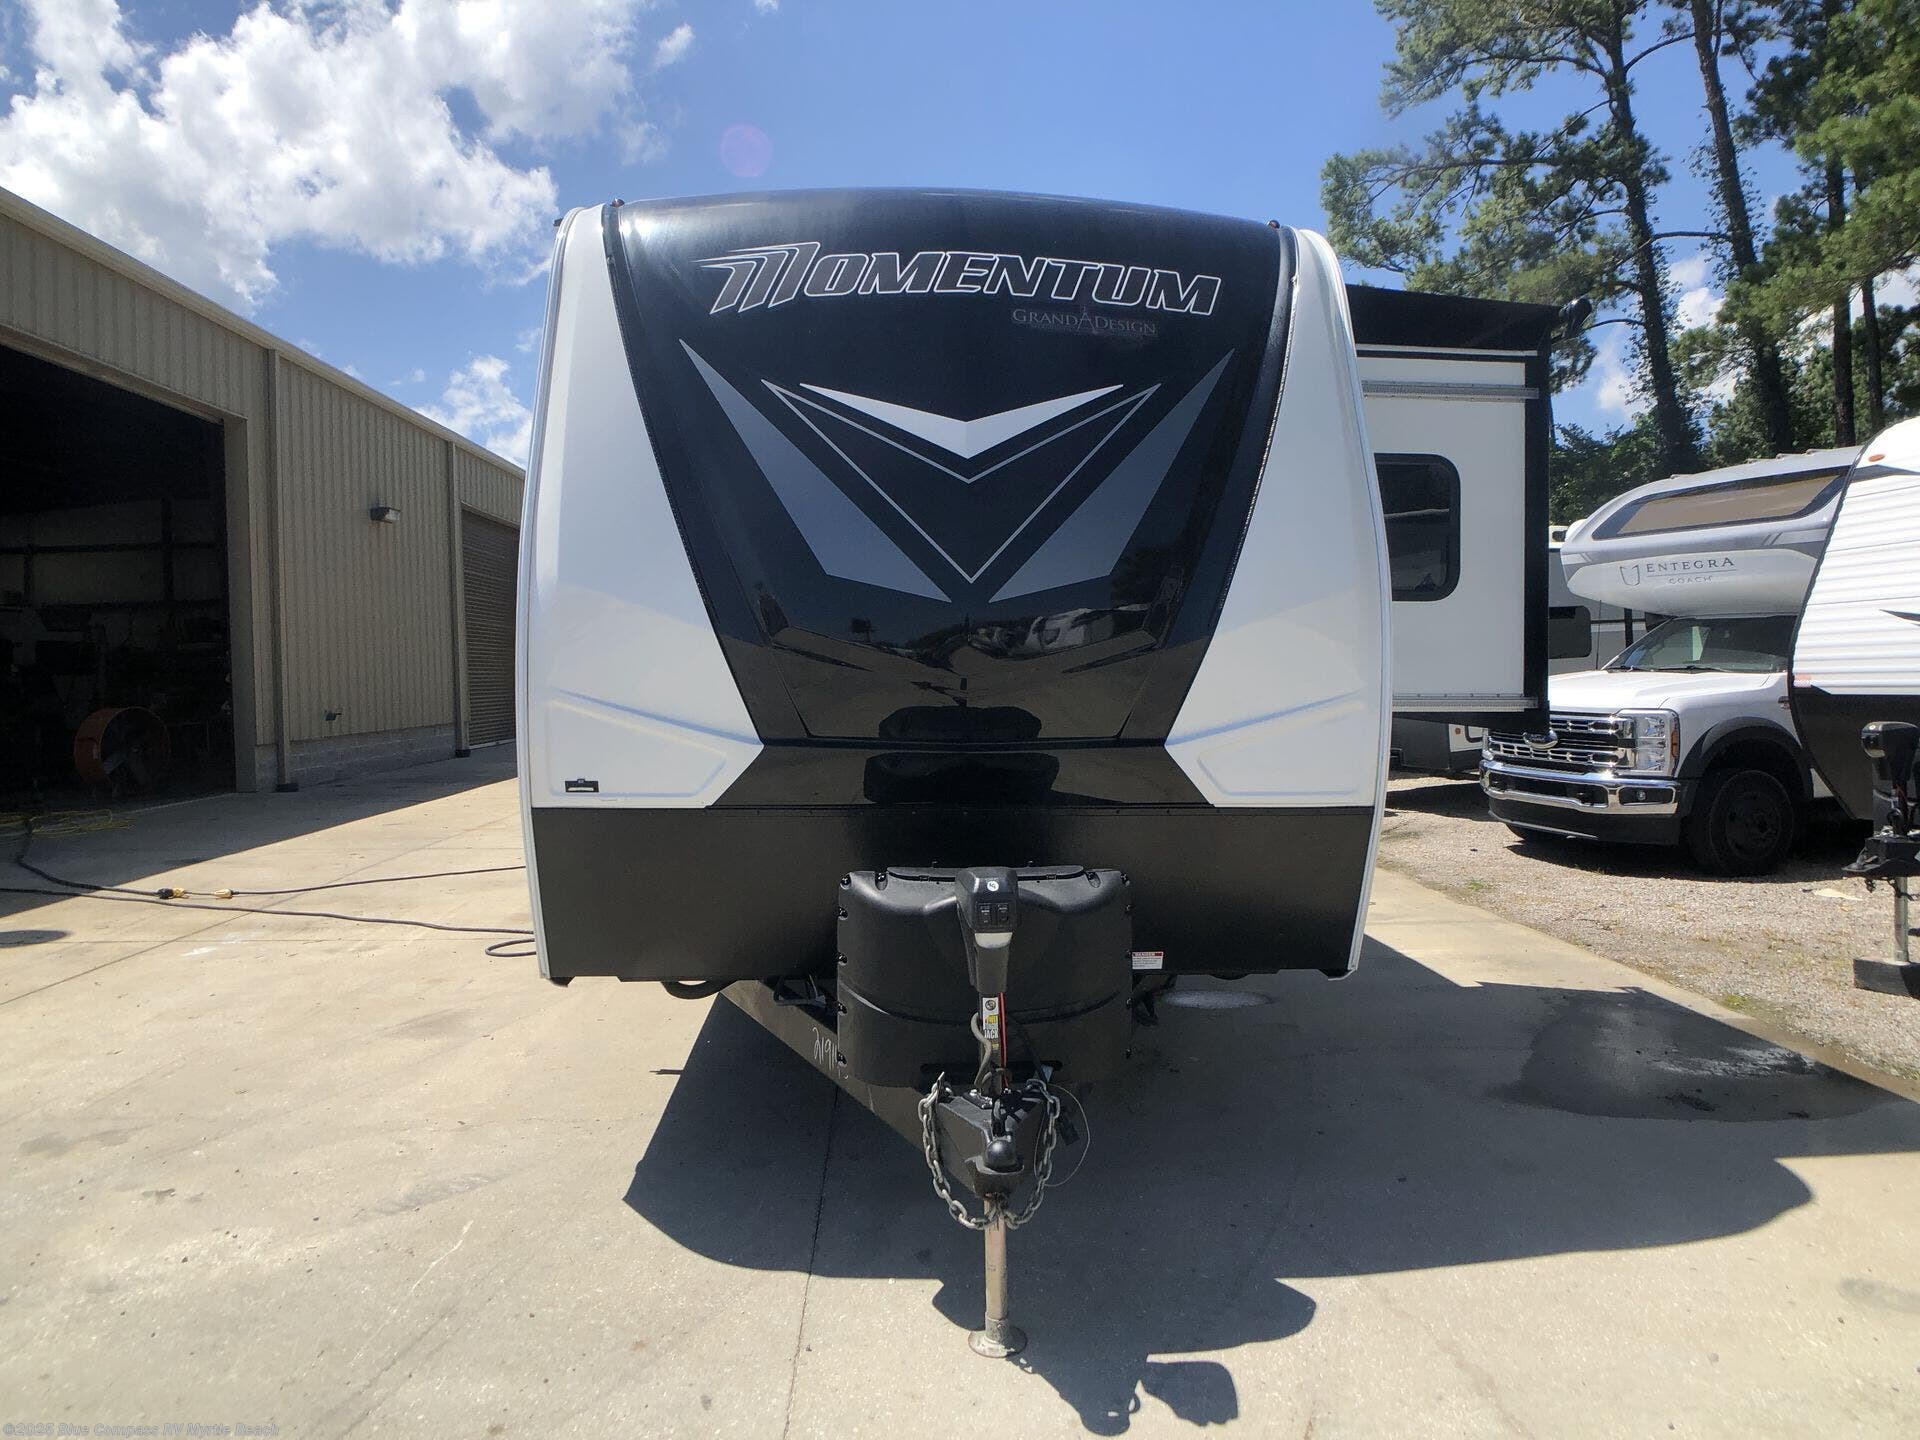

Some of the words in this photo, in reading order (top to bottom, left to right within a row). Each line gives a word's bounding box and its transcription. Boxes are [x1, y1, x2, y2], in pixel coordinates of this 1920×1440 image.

[690, 241, 1221, 315] MOMENTUM
[1646, 557, 1735, 573] ENTEGRA
[1669, 575, 1713, 585] COACH
